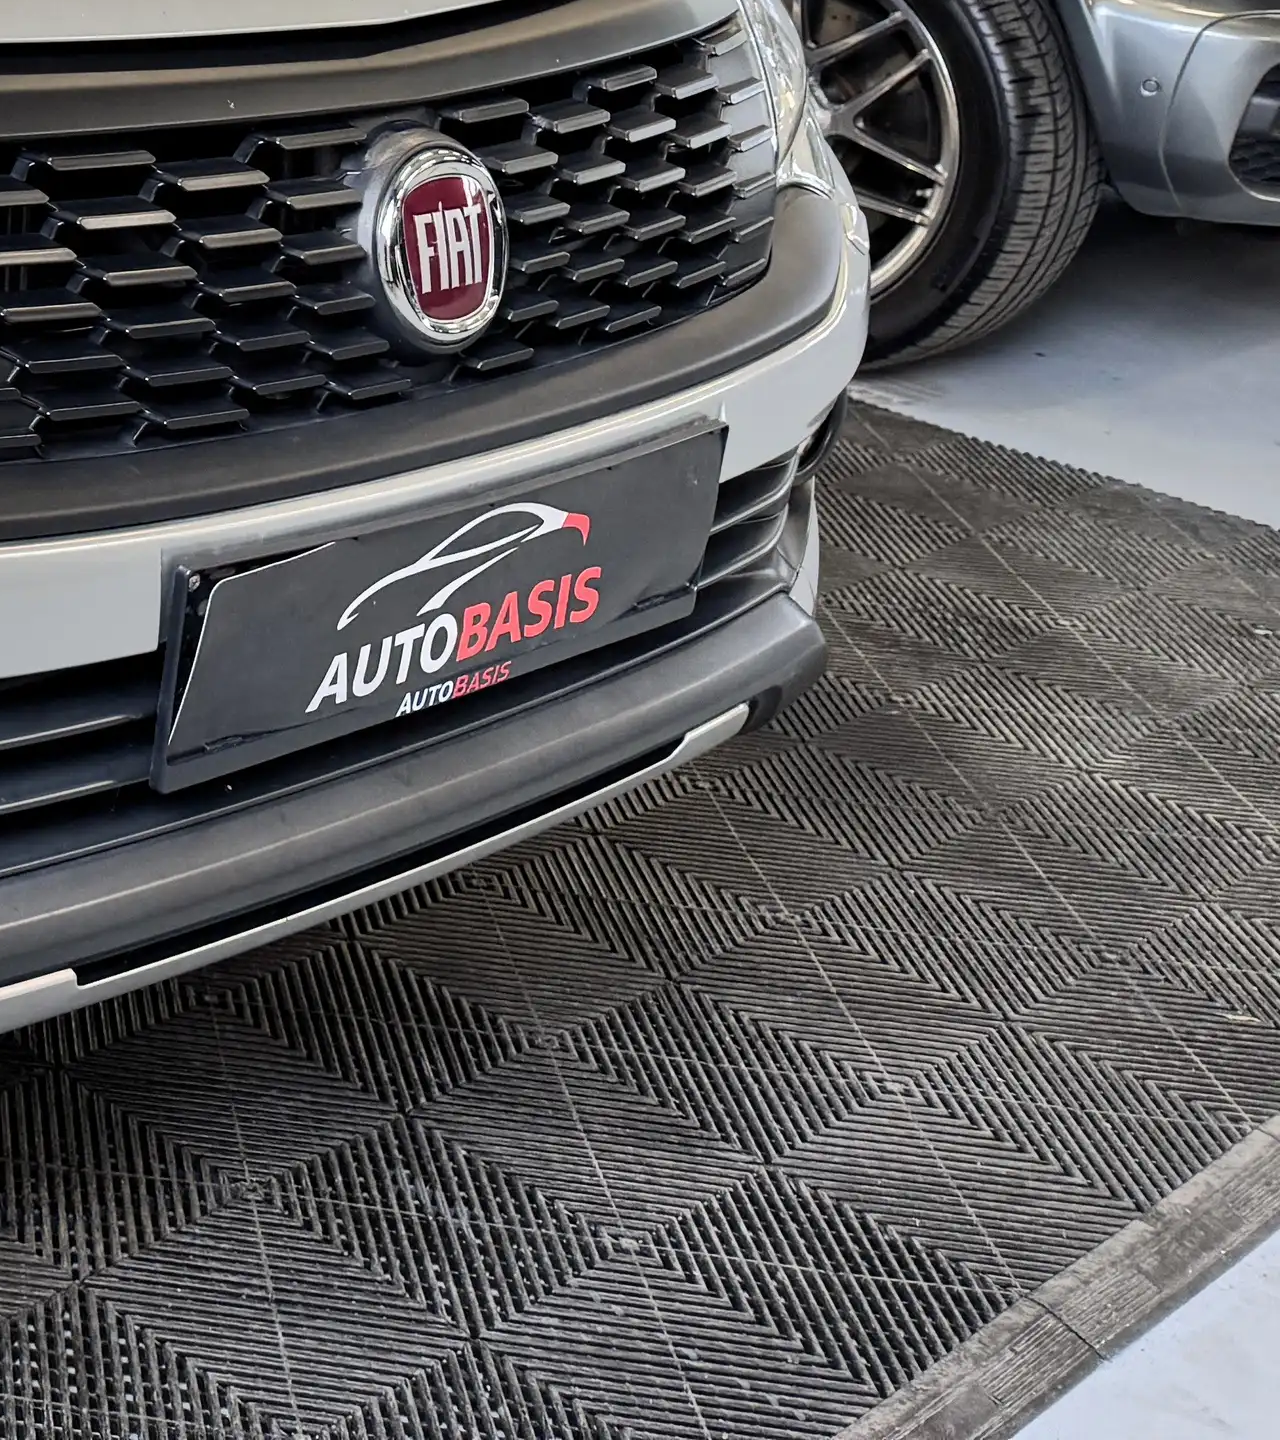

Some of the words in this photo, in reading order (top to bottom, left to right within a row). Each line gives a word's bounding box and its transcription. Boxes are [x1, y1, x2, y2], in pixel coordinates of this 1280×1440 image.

[412, 202, 483, 295] FIAT
[305, 566, 601, 713] AUTOBASIS
[396, 661, 512, 716] AUTOBASIS
